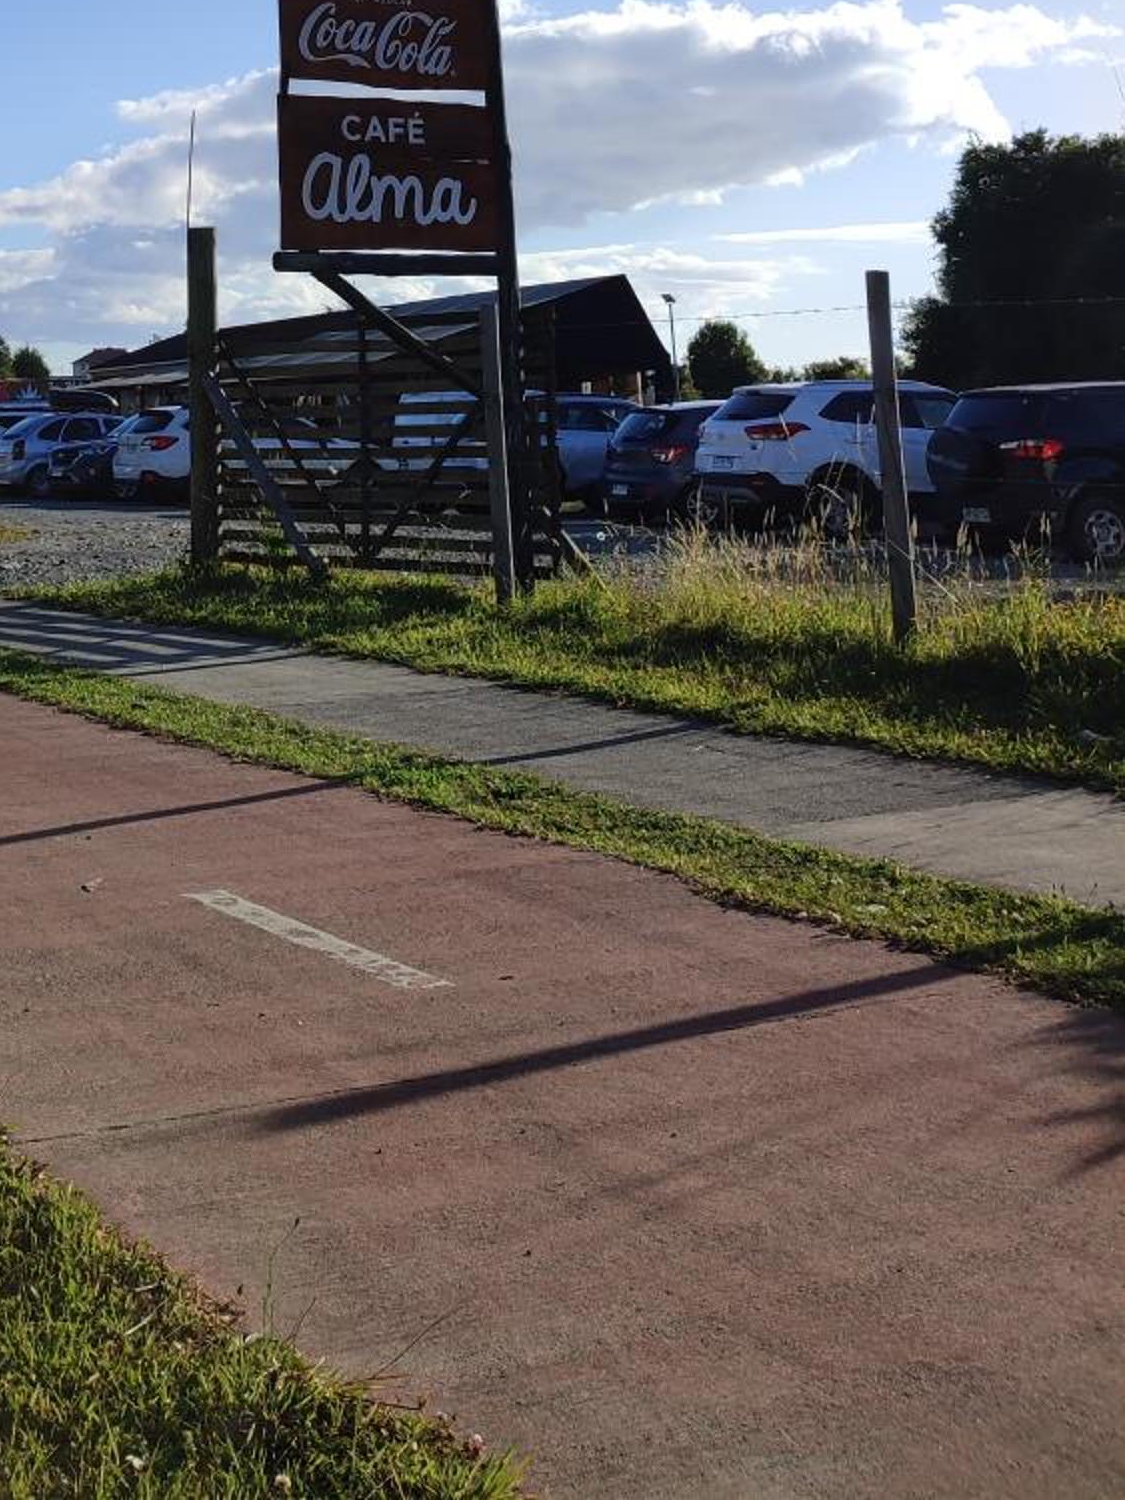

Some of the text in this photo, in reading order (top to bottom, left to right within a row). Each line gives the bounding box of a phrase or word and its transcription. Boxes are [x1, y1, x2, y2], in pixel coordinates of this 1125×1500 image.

[299, 2, 457, 76] Coca Cola
[341, 111, 426, 144] CAFÉ
[302, 152, 478, 226] Alma
